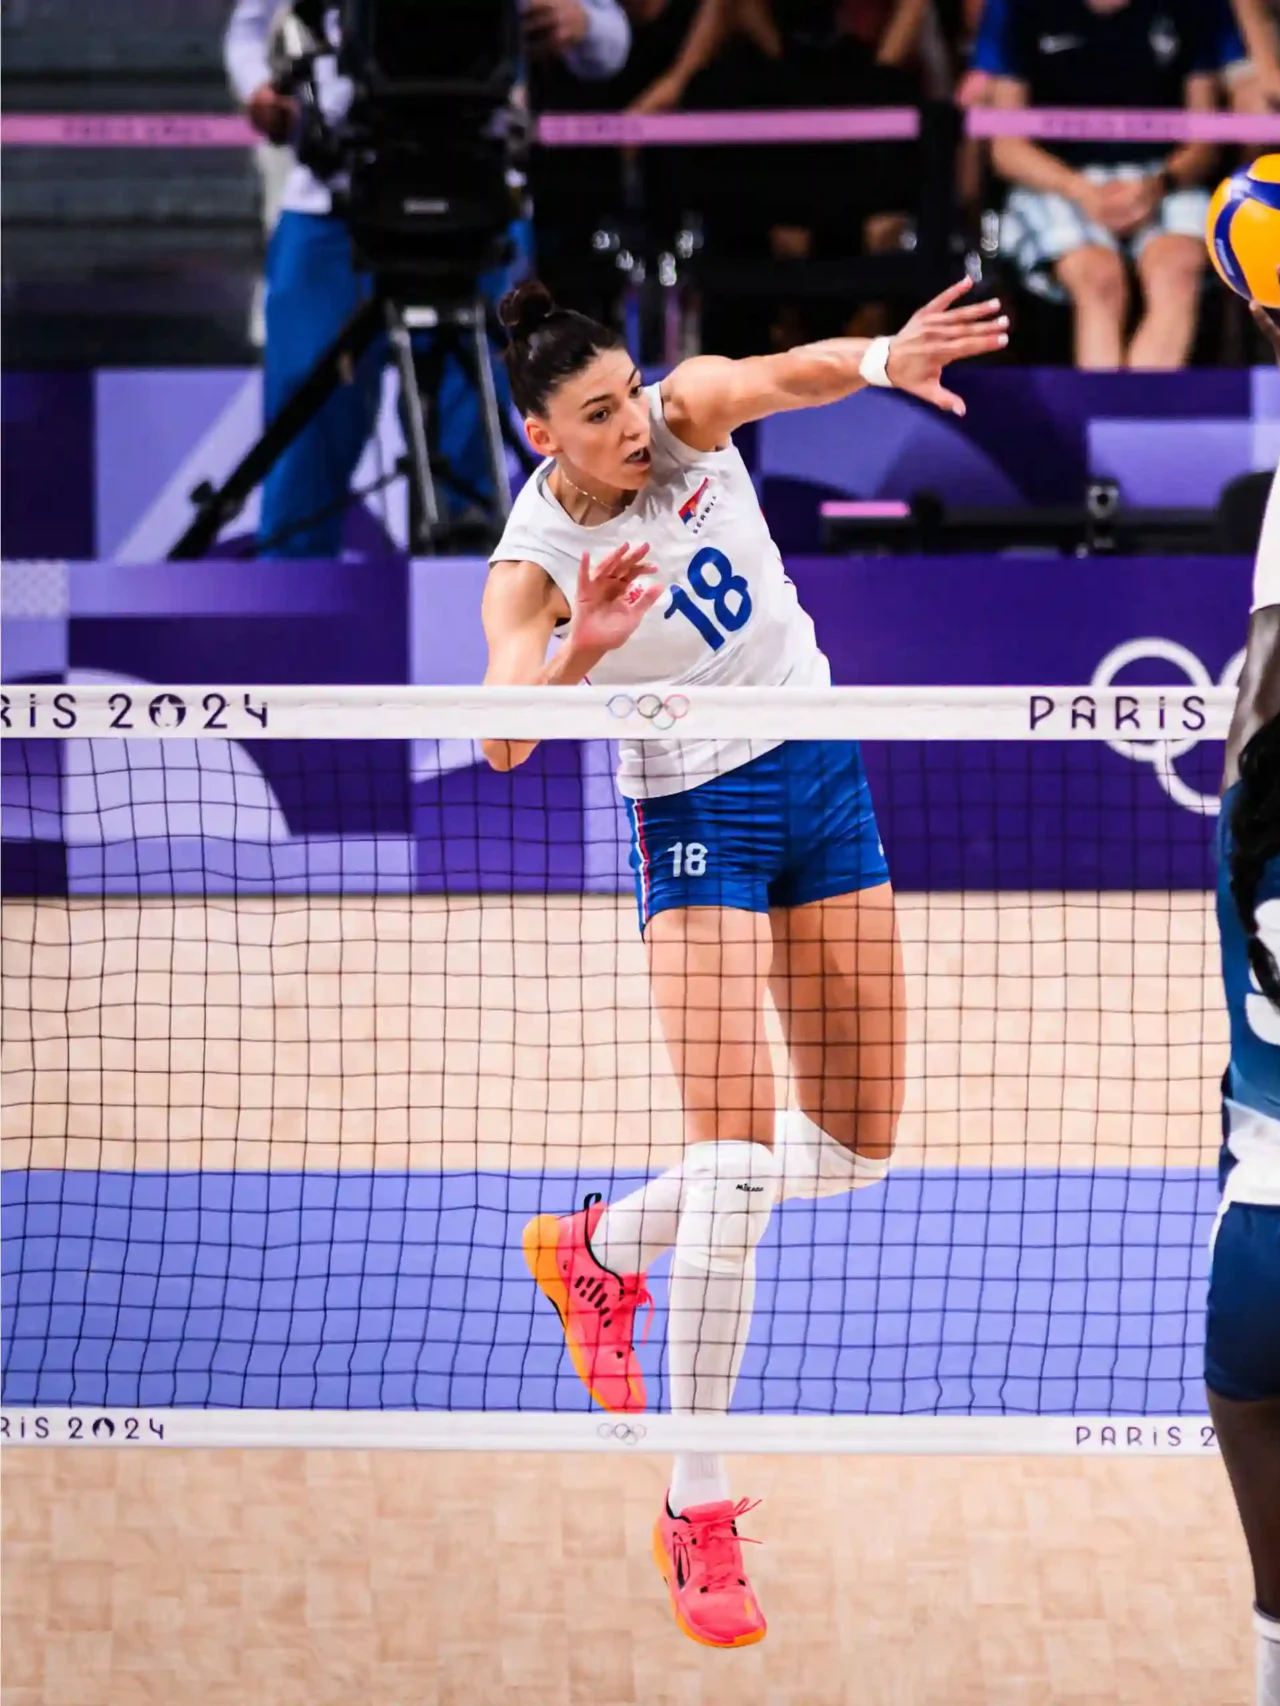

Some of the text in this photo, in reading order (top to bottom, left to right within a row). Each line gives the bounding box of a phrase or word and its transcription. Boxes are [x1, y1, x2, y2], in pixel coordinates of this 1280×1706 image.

[664, 546, 753, 652] 18
[108, 693, 268, 729] 2024
[667, 841, 709, 878] 18
[68, 1416, 164, 1440] 2024
